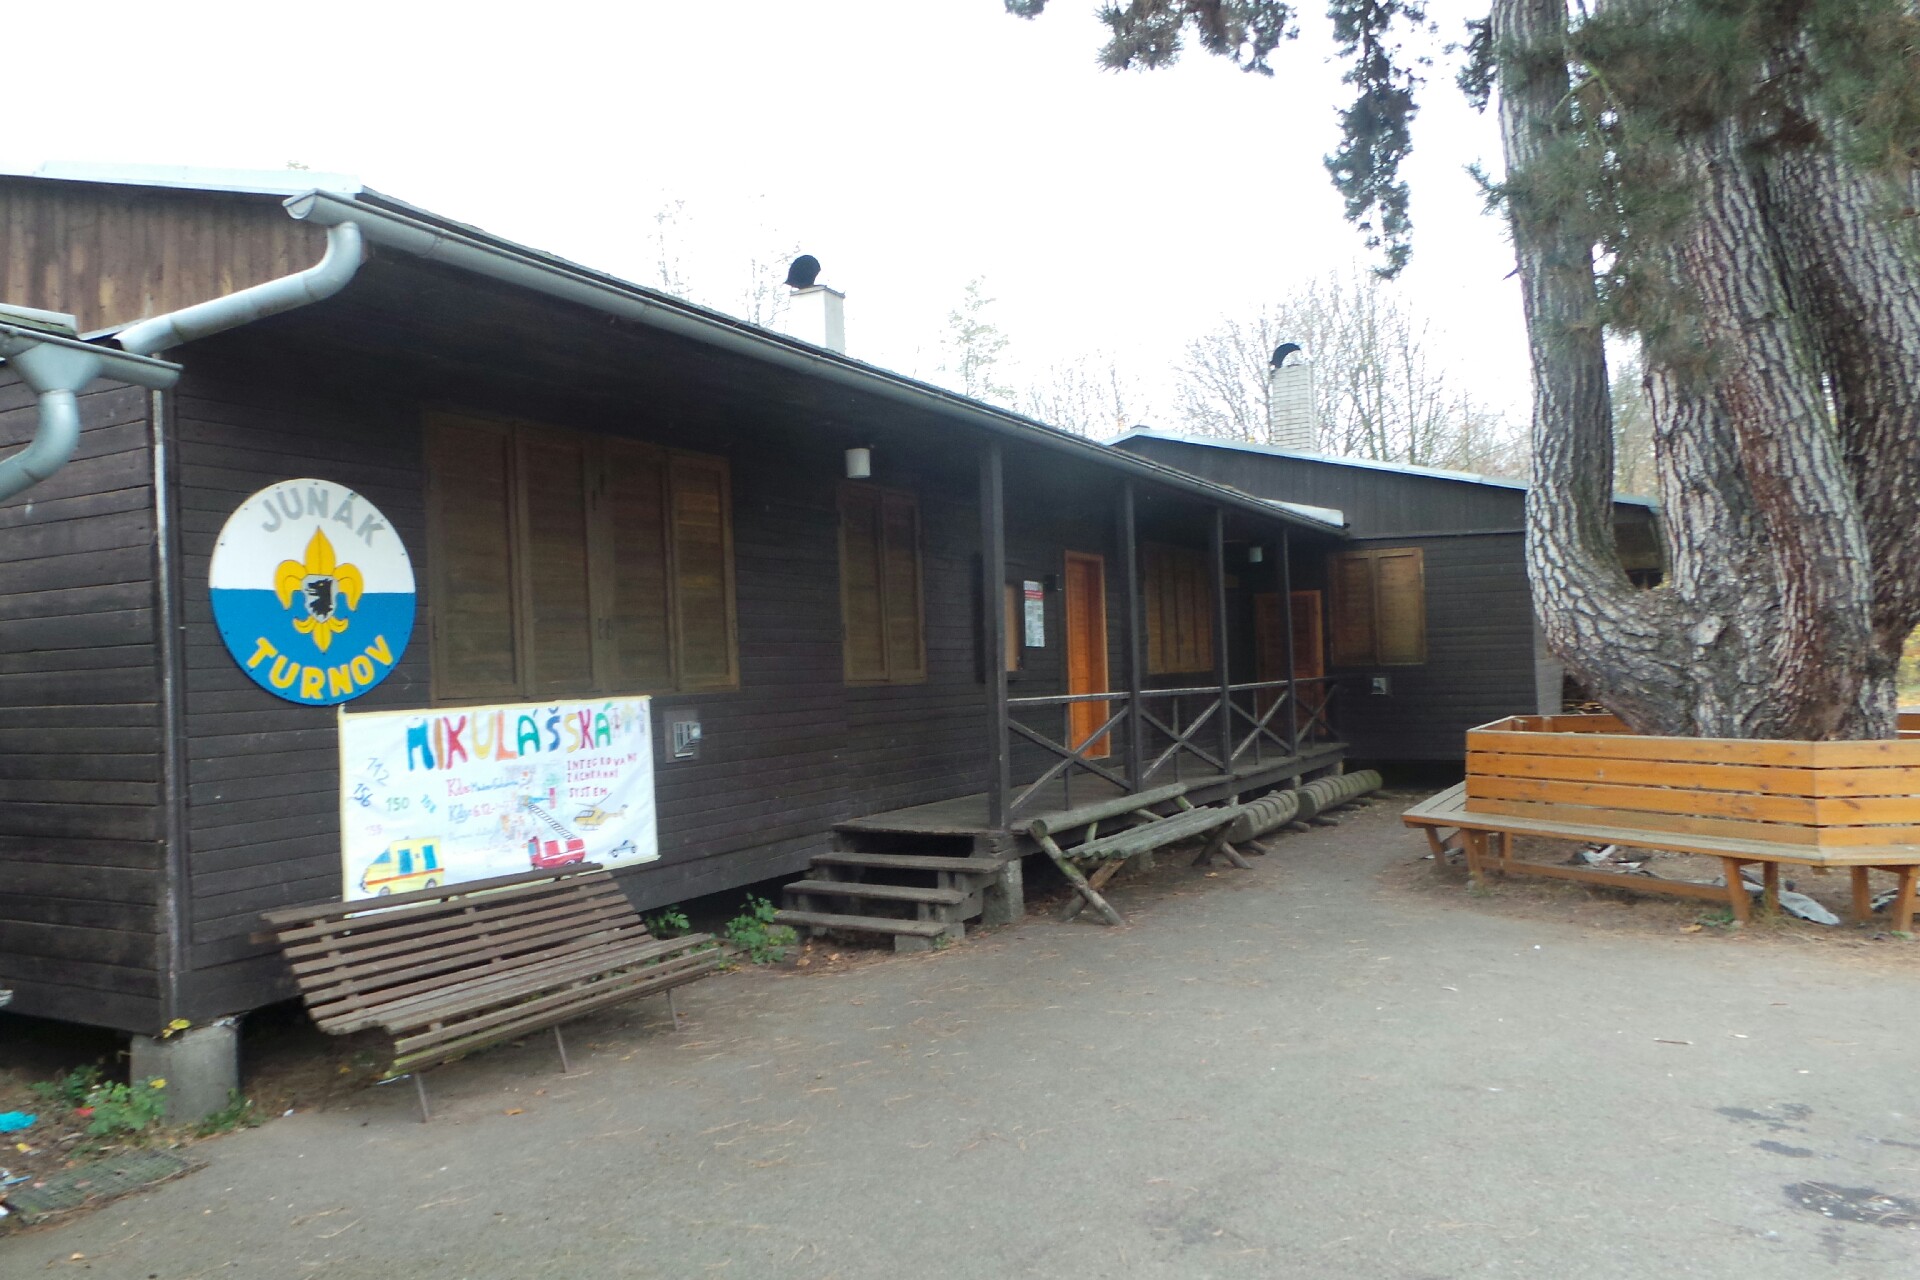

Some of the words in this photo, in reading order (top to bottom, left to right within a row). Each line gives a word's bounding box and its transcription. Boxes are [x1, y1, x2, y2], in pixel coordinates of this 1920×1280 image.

[247, 634, 394, 699] TURNOV
[406, 702, 612, 771] MIKULÁŠSKÁ
[385, 796, 410, 812] 150
